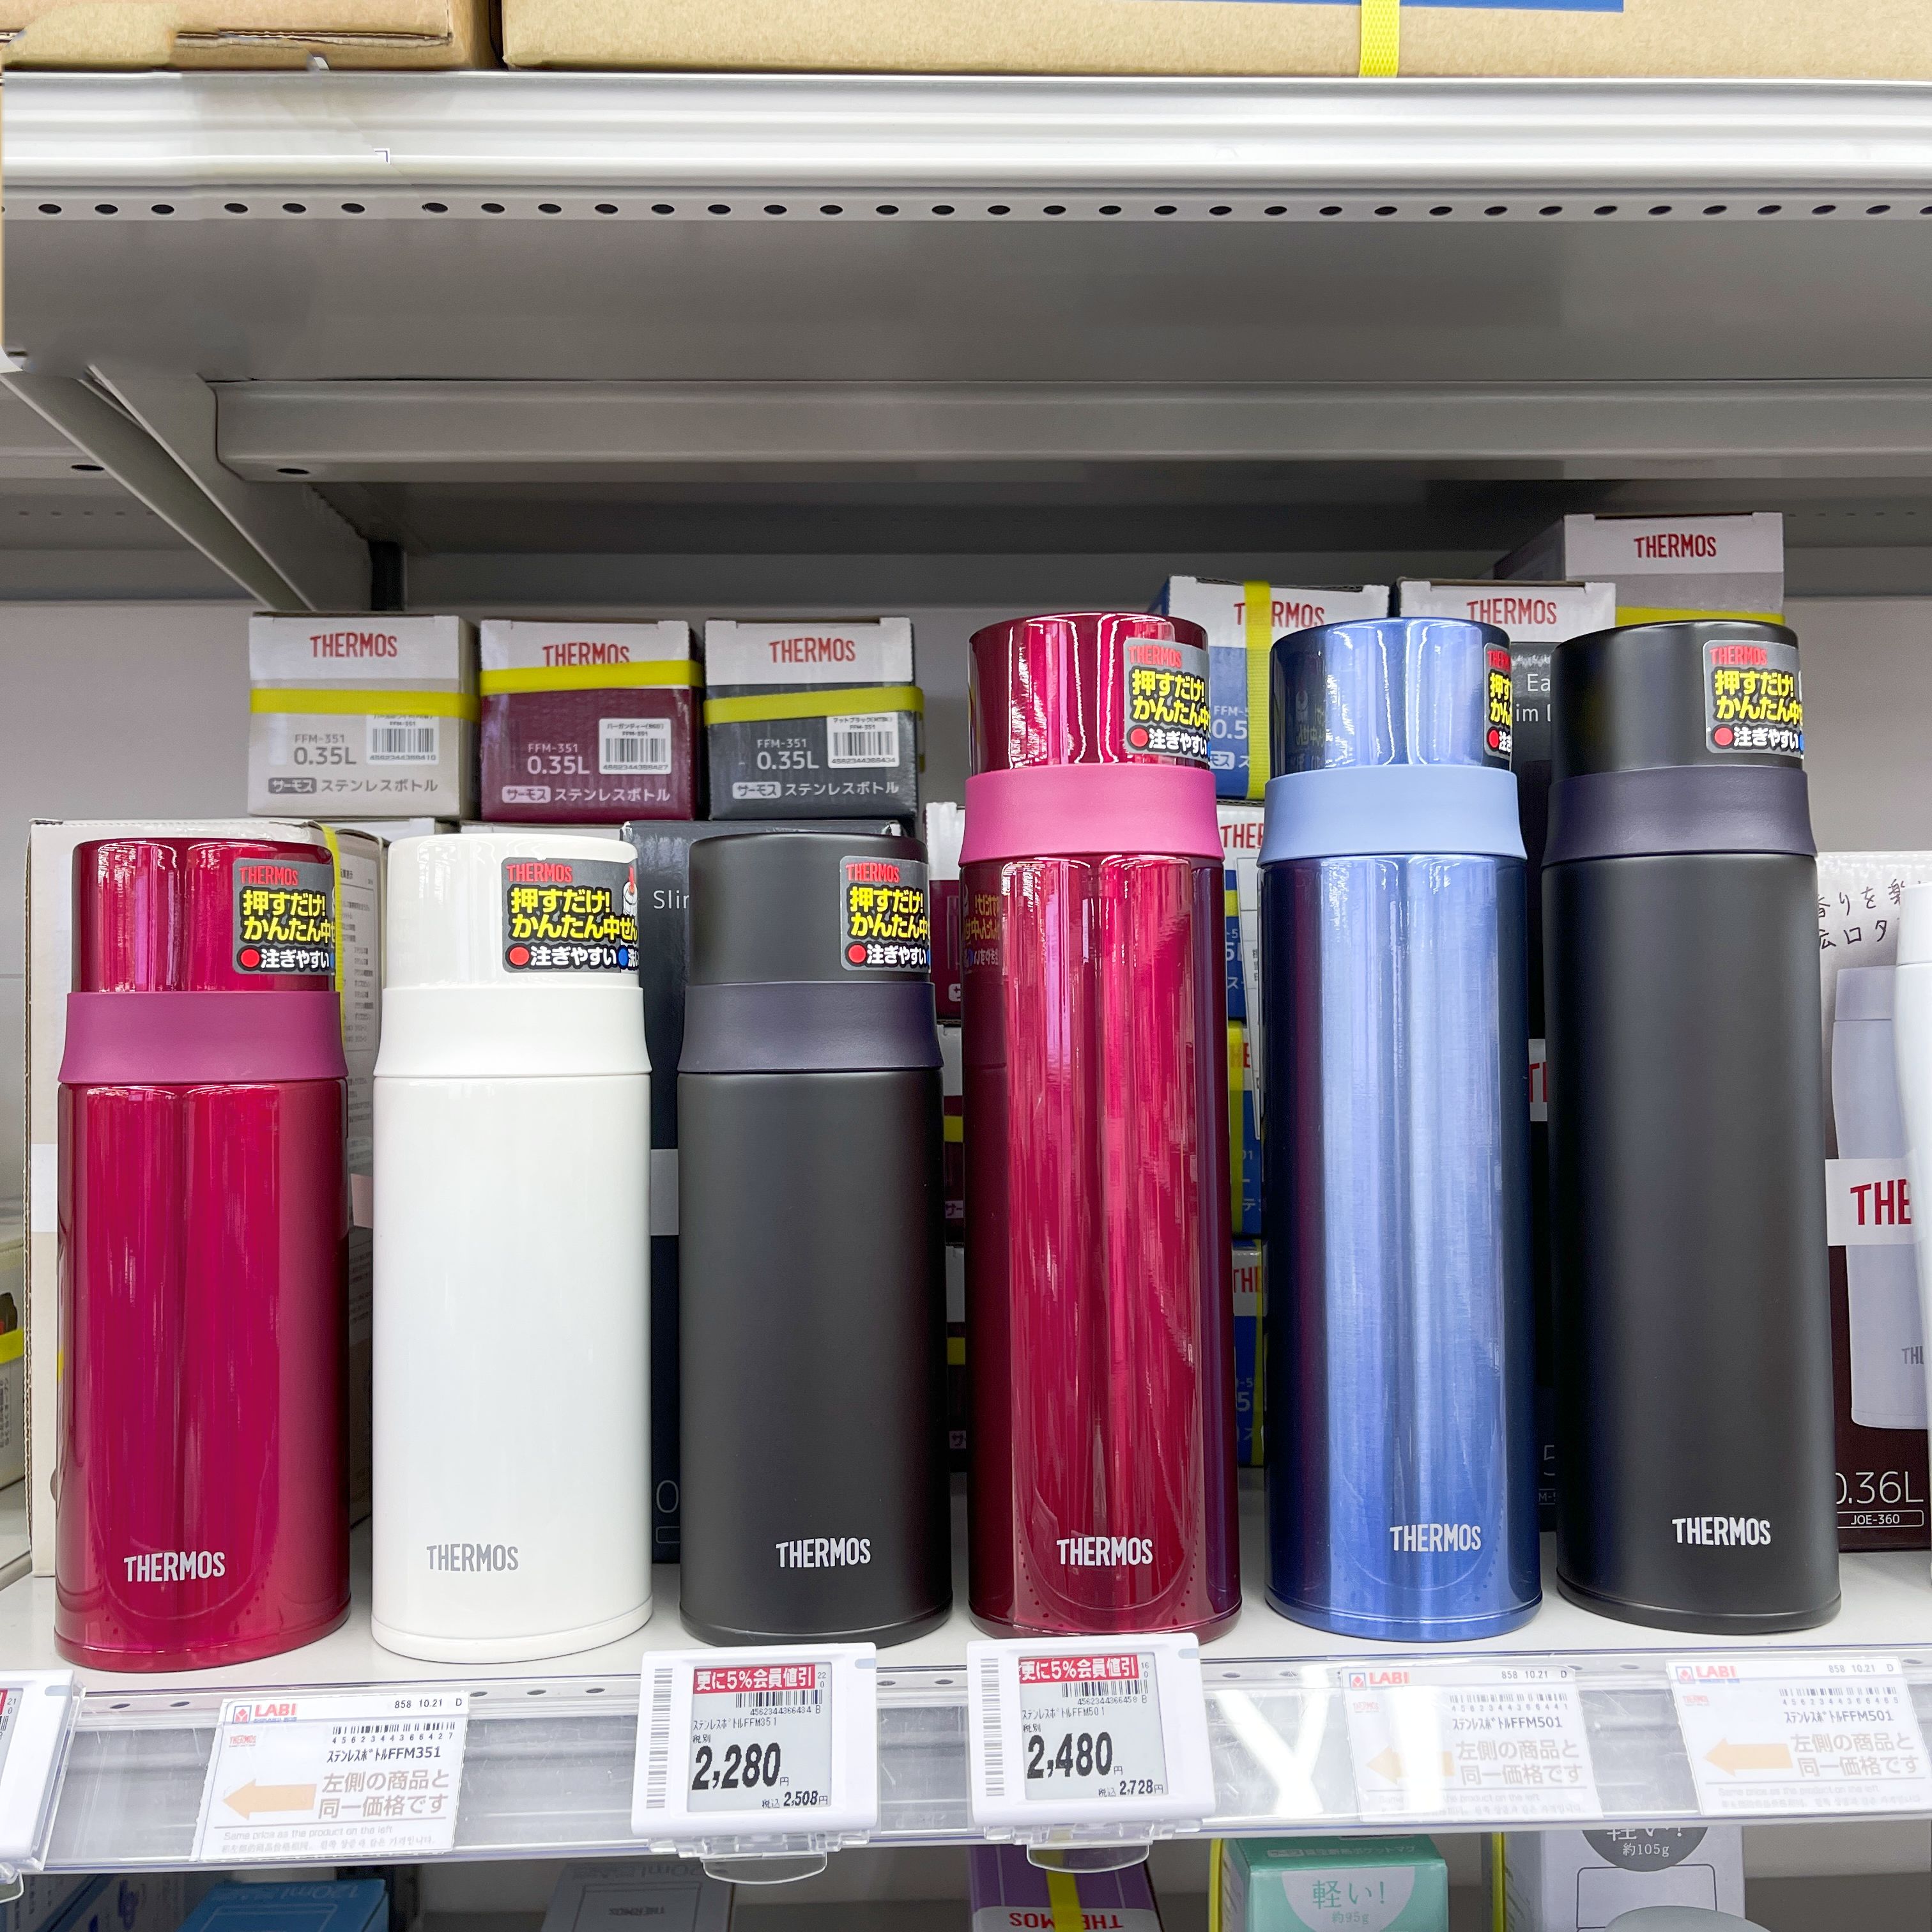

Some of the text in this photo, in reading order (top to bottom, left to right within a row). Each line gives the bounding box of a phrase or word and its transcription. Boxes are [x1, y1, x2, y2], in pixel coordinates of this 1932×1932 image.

[1634, 534, 1717, 558] THERMOS
[1234, 601, 1324, 628] TRMOS
[1467, 598, 1557, 624] THERMOS
[310, 632, 397, 658] THERMOS
[542, 642, 630, 667] THERMOS
[770, 638, 855, 663] THERMOS
[1710, 645, 1768, 665] THERMOS
[1128, 645, 1181, 668] THERMOS
[1132, 670, 1204, 702] 押すだけ!
[1715, 670, 1794, 697] 押すだけ!
[1133, 696, 1210, 732] かんたん中
[295, 734, 345, 744] FFM-351
[757, 739, 807, 749] FFM-351
[1733, 726, 1798, 749] 注ぎやすい
[294, 747, 356, 765] 0.35L
[528, 744, 578, 753] FFM-351
[527, 756, 590, 775] 0.35L
[757, 751, 819, 770] 0.35L
[272, 778, 438, 793] サーモス ステンレスボトル
[506, 789, 670, 802] サーモス ステンレスボトル
[737, 782, 900, 797] サーモス ステンレスボトル
[239, 866, 298, 886] THERMOS
[506, 862, 572, 883] THERMOS
[846, 862, 900, 883] THERMOS
[243, 890, 325, 917] 押すだけ!
[511, 887, 610, 914] 押すだけ!
[850, 886, 923, 914] 押すだけ!
[261, 948, 330, 969] 注ぎやすい
[530, 946, 617, 966] 注ぎやすい
[866, 944, 926, 965] 注ぎやすい
[1851, 1514, 1899, 1525] JOE-360
[1390, 1523, 1481, 1552] THERMOS
[1672, 1516, 1771, 1545] THERMOS
[427, 1544, 518, 1572] THERMOS
[776, 1537, 871, 1568] THERMOS
[1057, 1537, 1153, 1566] THERMOS
[124, 1551, 225, 1583] THERMOS
[696, 1667, 811, 1691] 更に5%会員値引
[1021, 1657, 1135, 1681] 更に5%会員値引
[1369, 1672, 1409, 1684] LABI
[1501, 1671, 1518, 1679] 858
[1525, 1671, 1548, 1679] 10.21
[1696, 1666, 1736, 1678] LABI
[1829, 1664, 1894, 1673] 858 10.21 D
[255, 1703, 296, 1717] LABI
[394, 1698, 463, 1710] 858 10.21 D
[750, 1706, 811, 1715] 4562344366434
[1078, 1696, 1138, 1706] 4562344366458
[693, 1733, 711, 1744] 税別
[1023, 1723, 1041, 1733] 税別
[1455, 1740, 1579, 1760] 左側の商品と
[1791, 1733, 1914, 1753] 左側の商品と
[1461, 1765, 1583, 1785] 同一価格です
[1798, 1756, 1919, 1777] 同一価格です
[323, 1769, 450, 1794] 左側の商品と
[319, 1794, 449, 1820] 同一価格です
[1623, 1844, 1669, 1857] 約105g
[1312, 1880, 1385, 1909] 軽い!
[1009, 1913, 1123, 1930] THEMOS
